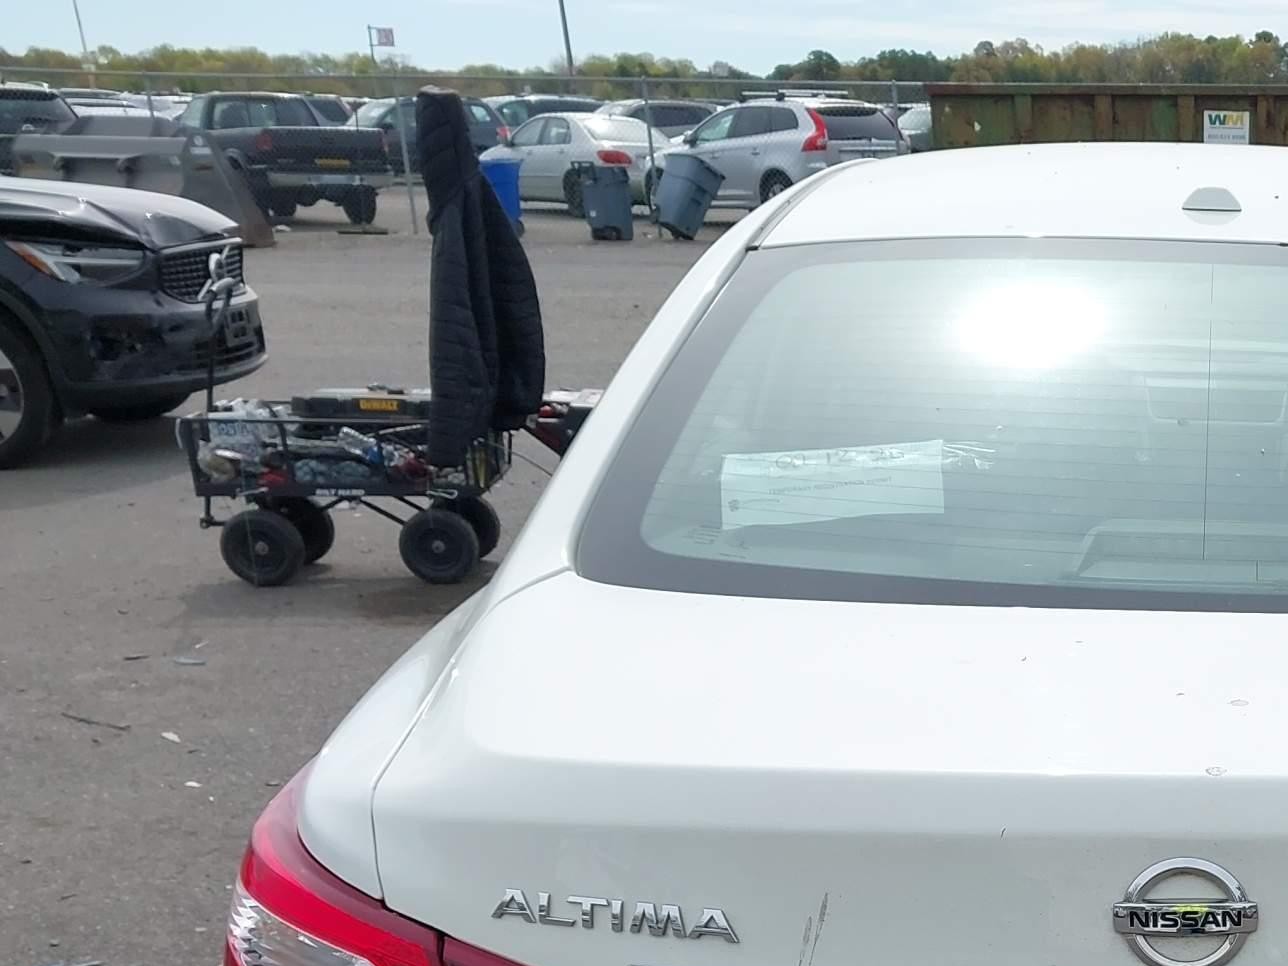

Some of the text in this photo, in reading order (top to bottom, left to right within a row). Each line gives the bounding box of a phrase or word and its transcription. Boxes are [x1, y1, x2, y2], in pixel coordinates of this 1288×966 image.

[1208, 114, 1244, 126] WM
[491, 888, 740, 943] ALTIMA
[1129, 911, 1242, 928] NISSAN
